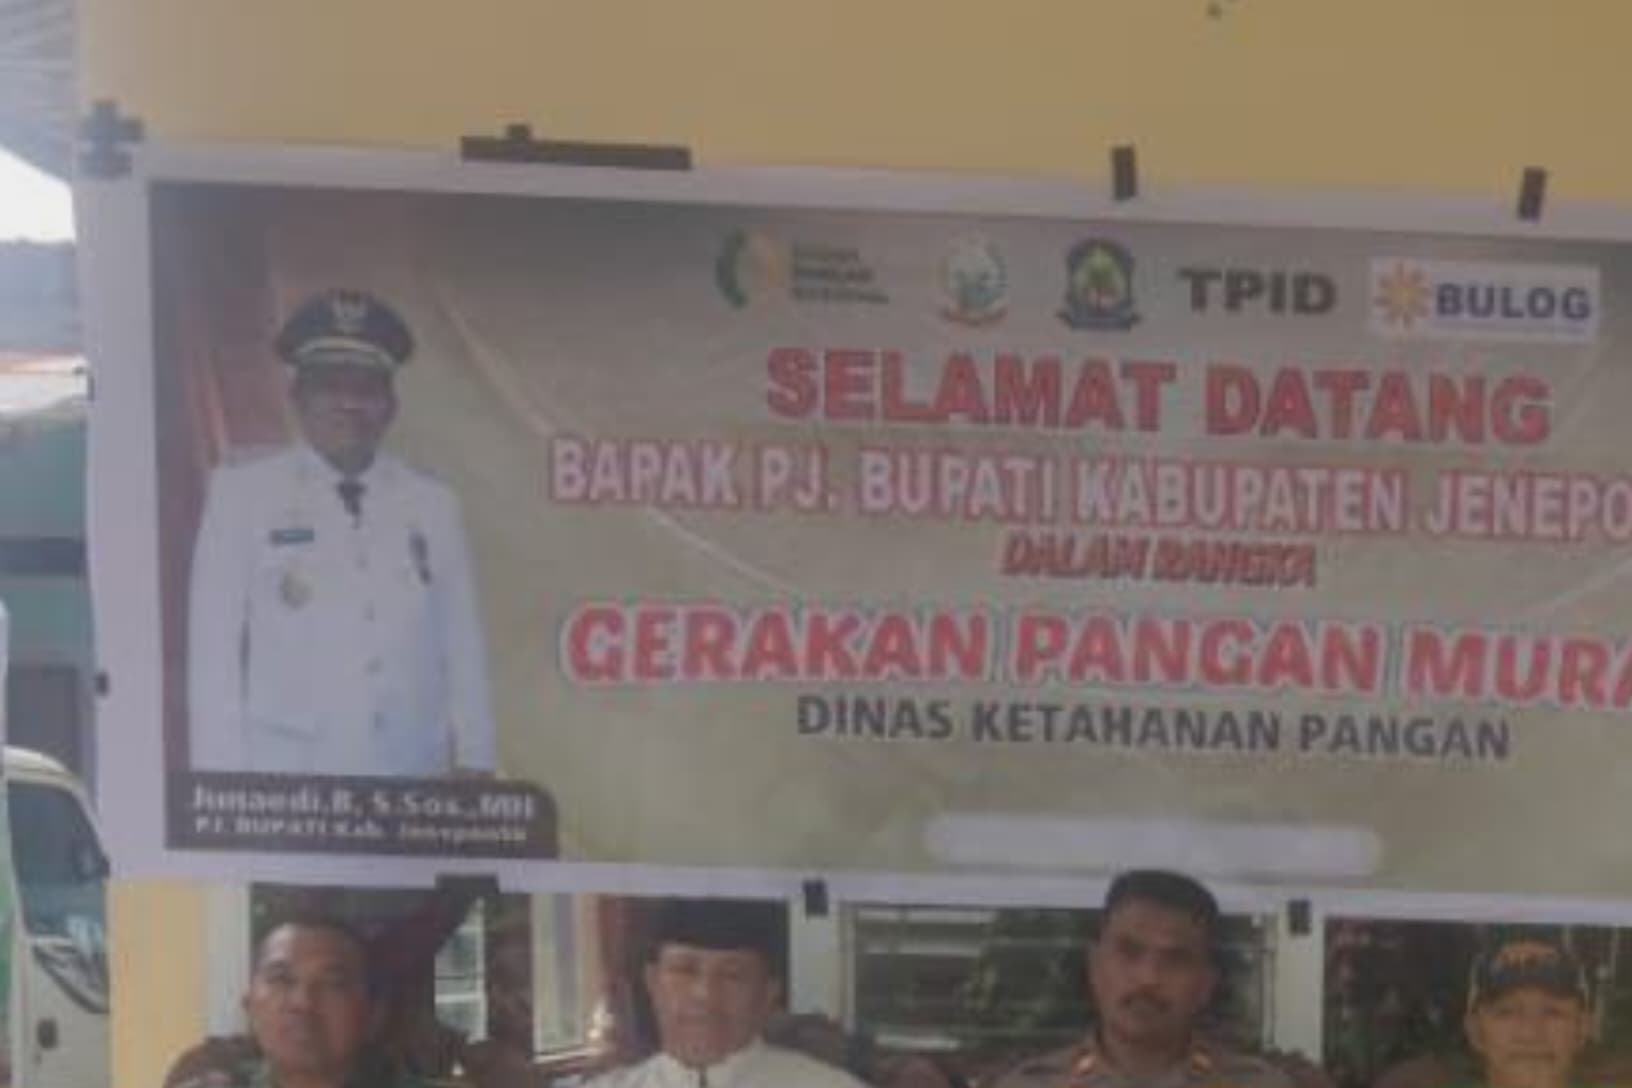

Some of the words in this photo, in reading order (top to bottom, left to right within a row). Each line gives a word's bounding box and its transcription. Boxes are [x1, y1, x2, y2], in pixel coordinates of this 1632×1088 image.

[1178, 266, 1338, 316] TPID
[1433, 281, 1593, 323] BULOG
[764, 347, 1178, 431] SELAMAT
[1204, 363, 1550, 447] DATANG
[549, 436, 740, 507] BAPAK
[755, 444, 836, 513] PJ.
[856, 446, 1060, 526] BUPATI
[1069, 455, 1403, 537] KABUPATEN
[1001, 533, 1152, 581] DALAM
[562, 603, 993, 682] GERAKAN
[1011, 612, 1386, 698] PANGAN
[797, 695, 953, 739] DINAS
[972, 702, 1281, 754] KETAHANAN
[1301, 713, 1511, 760] PANGAN
